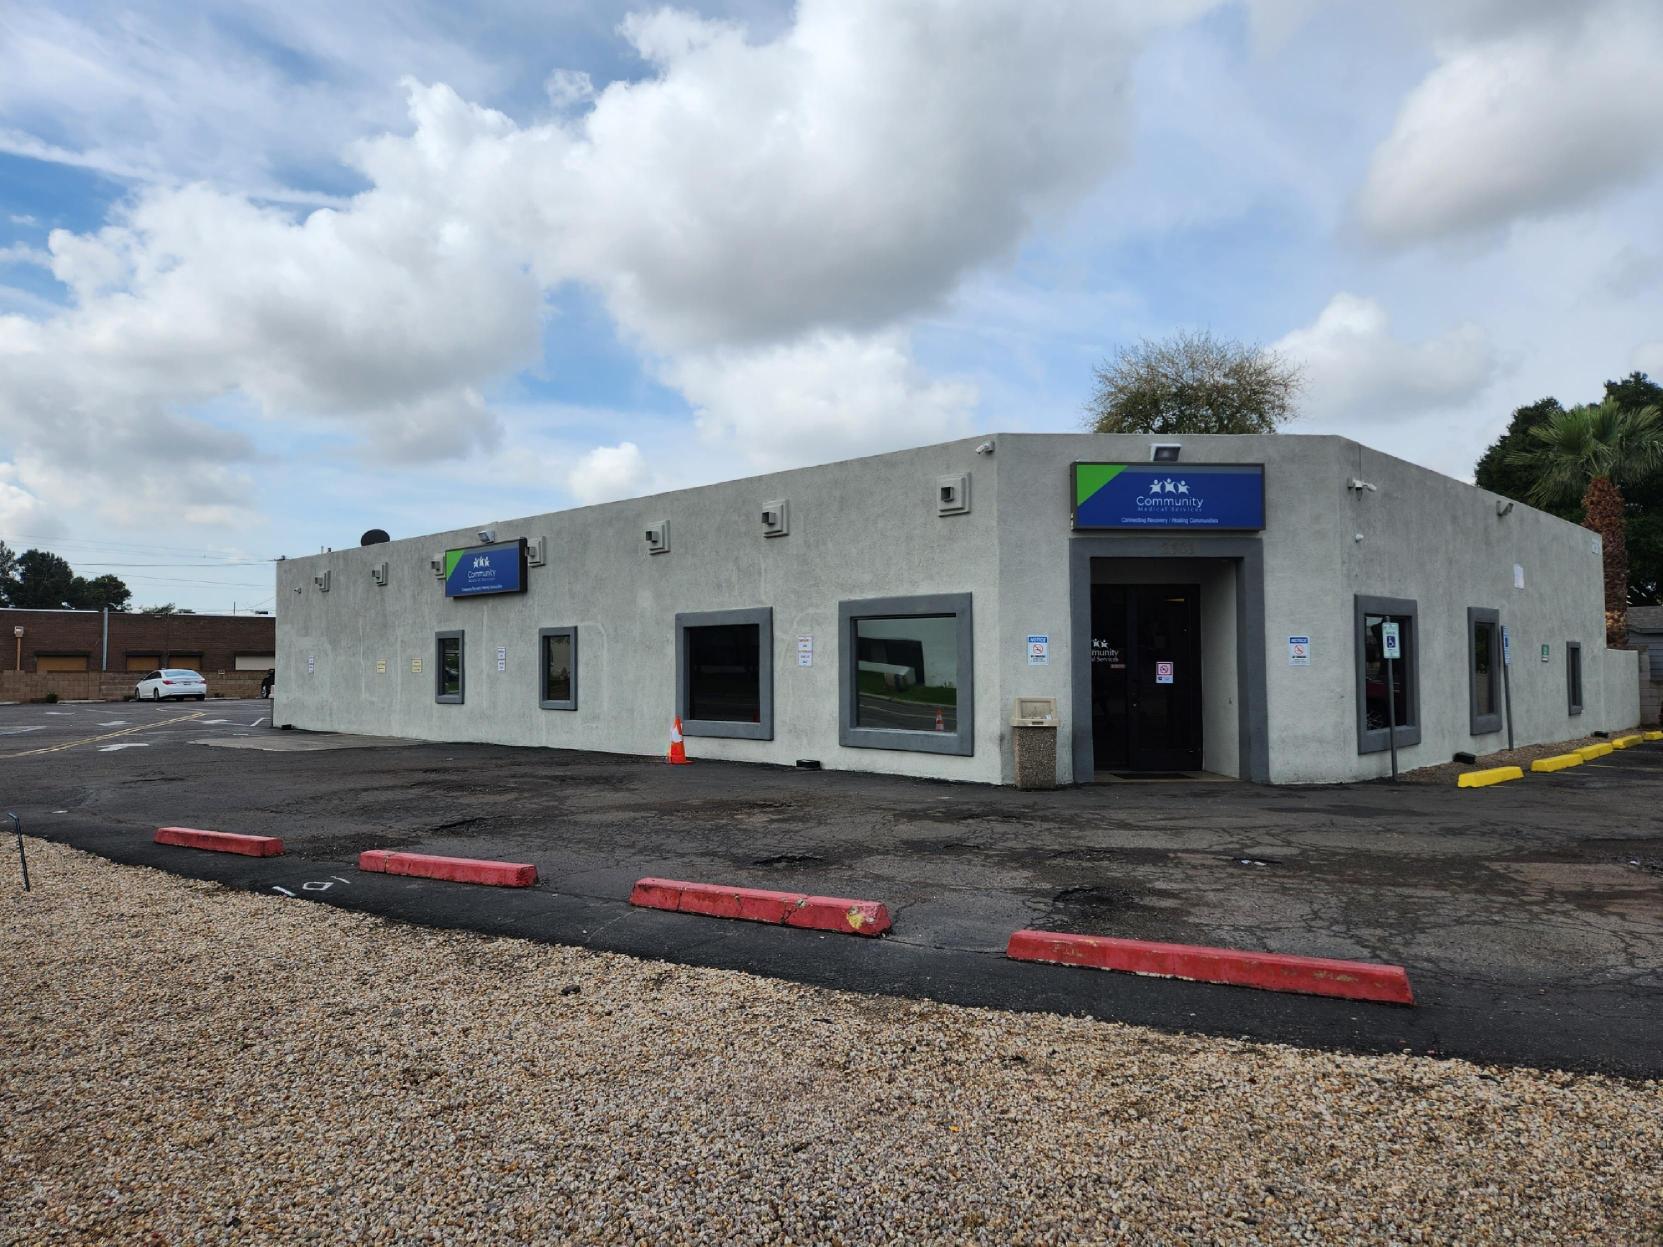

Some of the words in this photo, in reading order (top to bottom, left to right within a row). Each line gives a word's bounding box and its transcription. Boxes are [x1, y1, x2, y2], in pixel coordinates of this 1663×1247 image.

[1136, 496, 1204, 508] Community
[467, 570, 496, 579] Community
[1091, 648, 1119, 656] munity
